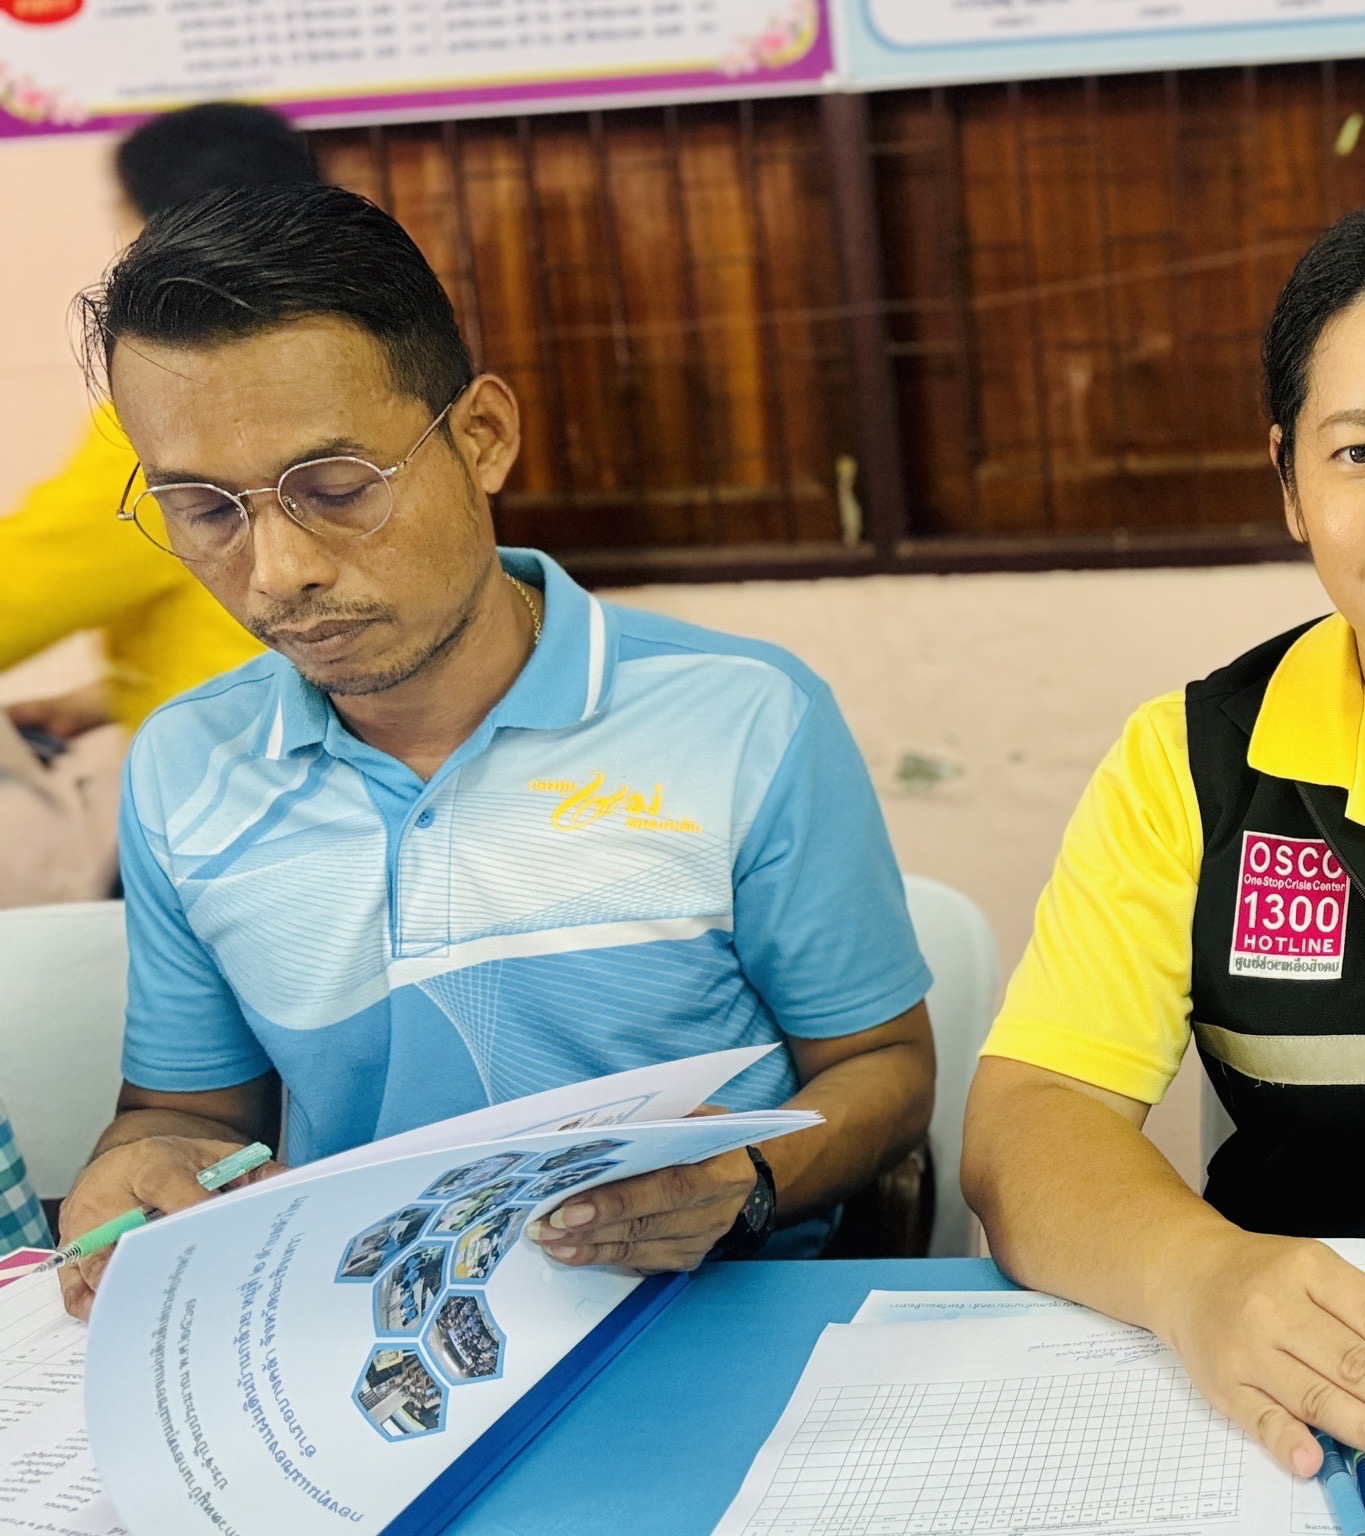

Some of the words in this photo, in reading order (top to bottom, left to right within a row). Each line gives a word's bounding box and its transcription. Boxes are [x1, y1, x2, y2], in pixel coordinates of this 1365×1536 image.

[1249, 841, 1343, 879] OSCC
[1244, 873, 1261, 886] One
[1263, 876, 1284, 890] Stop
[1284, 878, 1312, 890] Crisis
[1313, 880, 1345, 892] Center
[1244, 891, 1340, 933] 1300
[1243, 933, 1335, 954] HOTLINE
